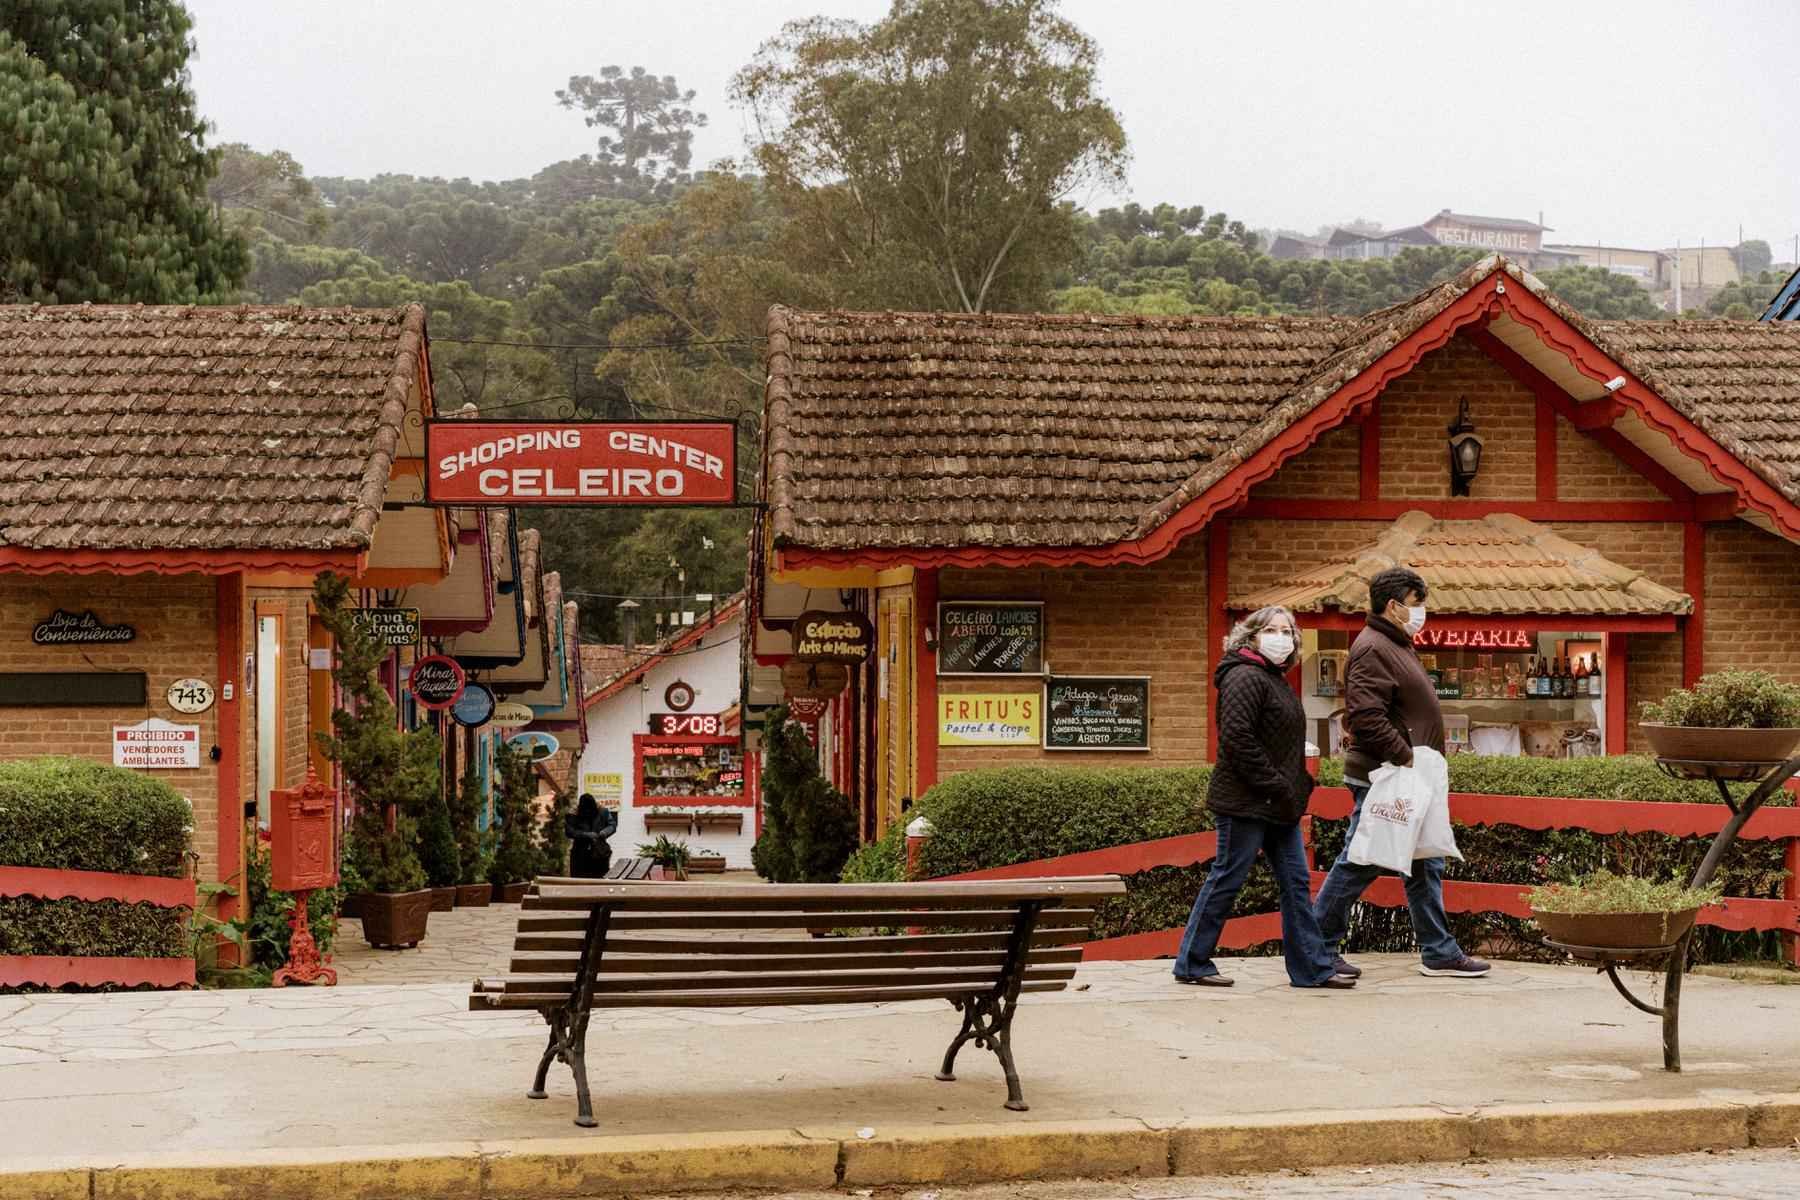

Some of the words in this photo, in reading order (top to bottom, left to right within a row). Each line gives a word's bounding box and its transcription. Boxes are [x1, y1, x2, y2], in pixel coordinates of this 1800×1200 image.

[1436, 226, 1528, 249] RESTAURANTE
[439, 429, 581, 479] SHOPPING
[609, 431, 723, 480] CENTER
[479, 468, 684, 497] CELEIRO
[80, 612, 96, 628] de
[34, 625, 132, 642] Conveniência
[806, 621, 861, 639] Estação
[951, 624, 997, 637] ABERTO
[1021, 624, 1033, 636] 29
[799, 640, 822, 654] Arte
[823, 641, 833, 653] de
[834, 641, 867, 657] Minas
[968, 636, 1002, 667] LANCHES
[174, 688, 207, 704] 743
[945, 699, 1032, 719] FRITU'S
[663, 716, 717, 734] 3/08
[945, 723, 983, 734] Pastel
[127, 731, 186, 741] PROIBIDO
[1077, 734, 1110, 744] ABERTO
[122, 746, 185, 754] VENDEDORES
